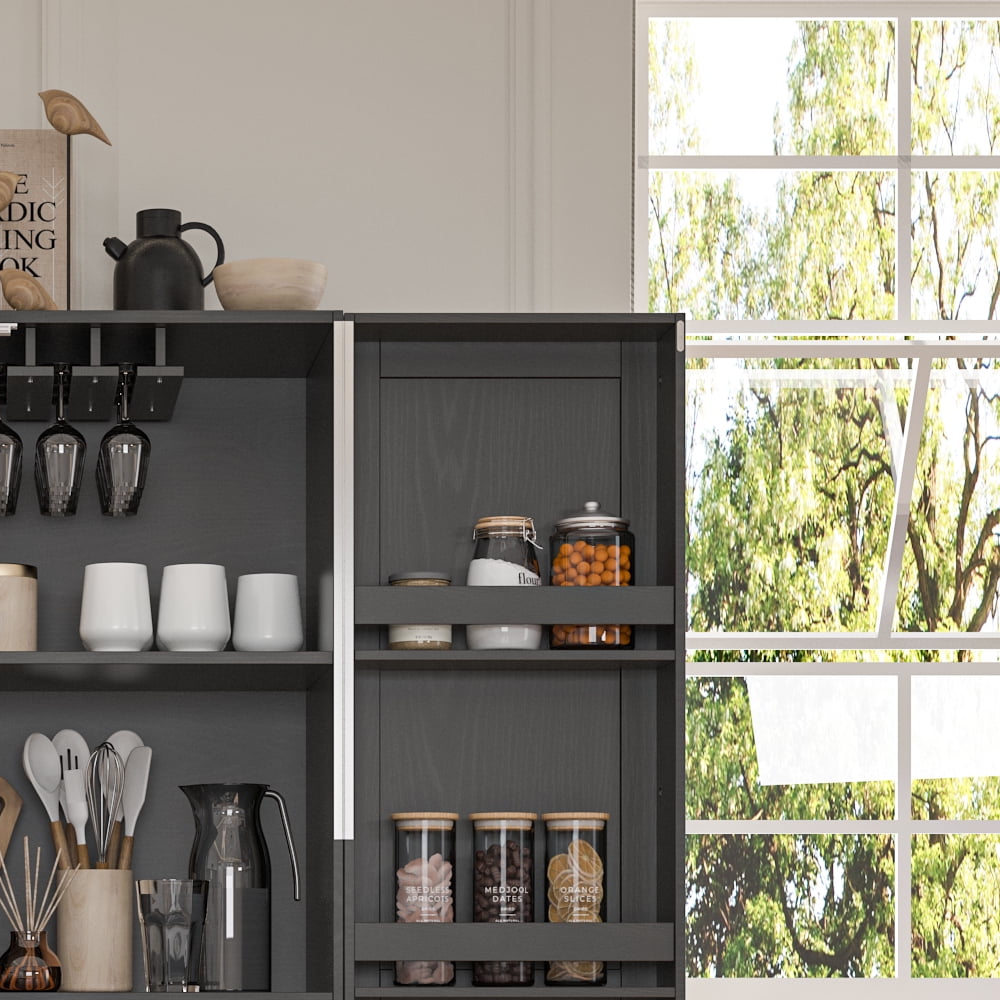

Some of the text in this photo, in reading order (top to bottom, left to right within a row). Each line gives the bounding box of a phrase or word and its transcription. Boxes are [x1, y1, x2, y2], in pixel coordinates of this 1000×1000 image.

[405, 886, 450, 894] SEEDLESS
[484, 886, 529, 894] MEDJOOL
[560, 886, 600, 894] ORANGE
[406, 895, 449, 903] APRICOTS
[492, 895, 523, 903] DATES
[564, 895, 598, 903] SLICES
